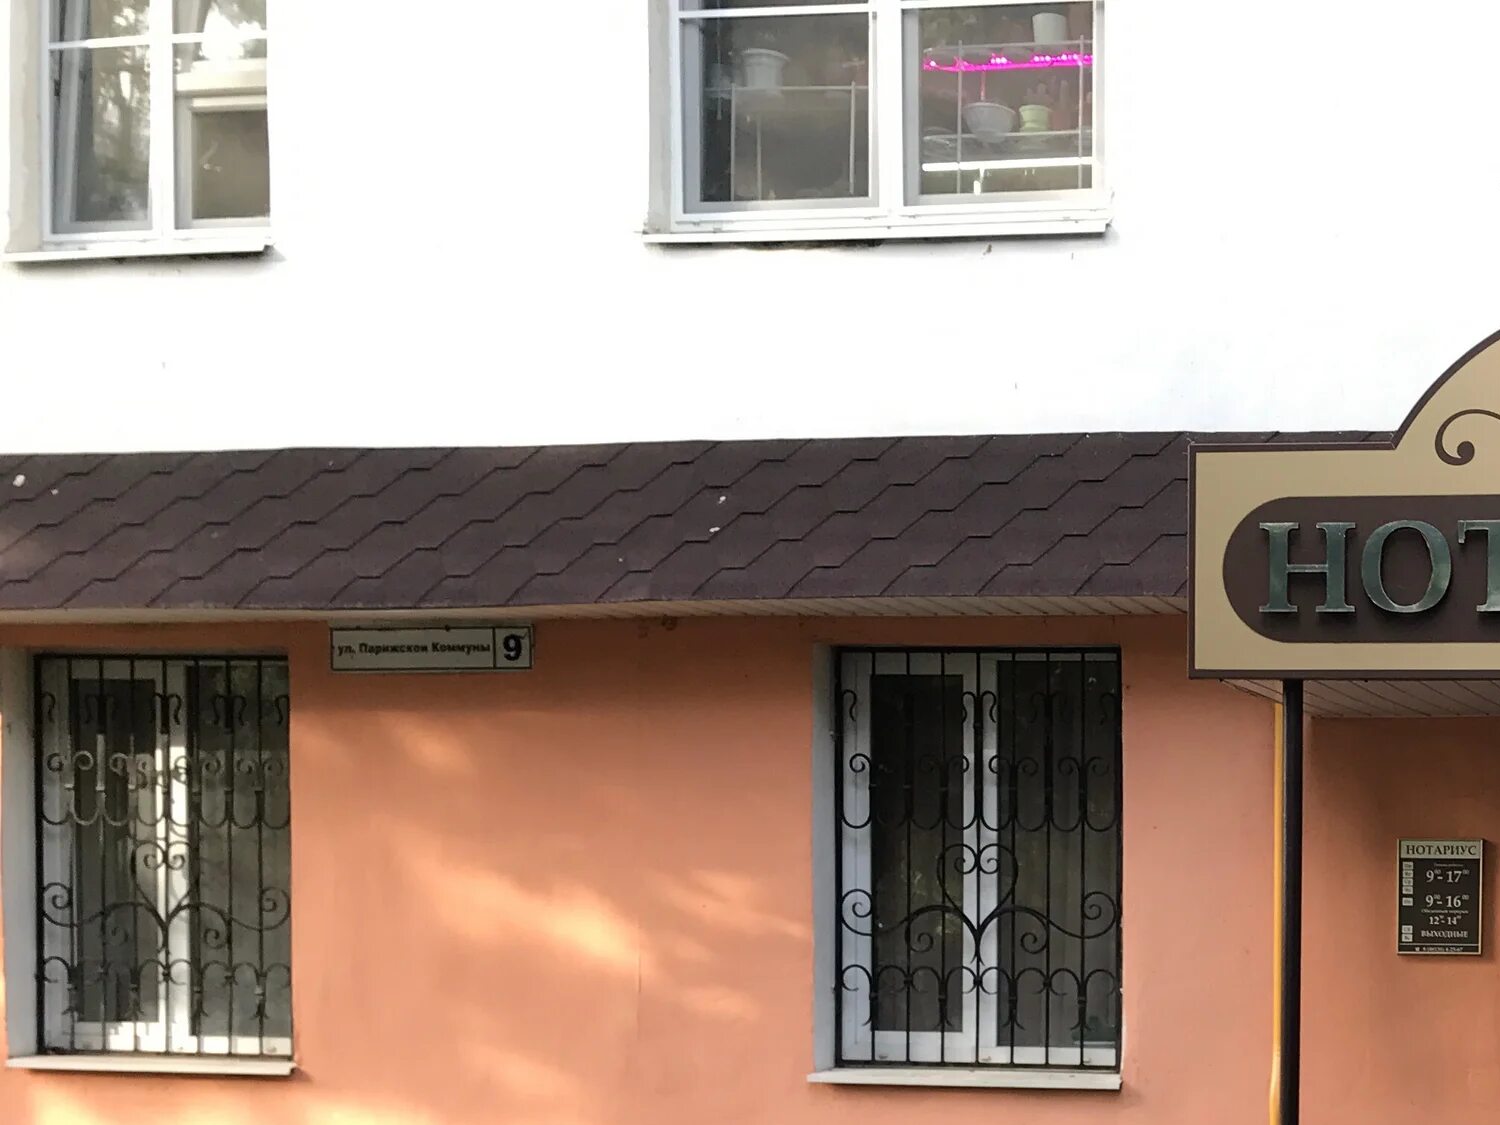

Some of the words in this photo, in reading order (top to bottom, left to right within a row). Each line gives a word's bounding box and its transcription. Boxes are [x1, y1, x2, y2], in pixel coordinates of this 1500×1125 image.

[431, 642, 491, 655] Коммуны
[503, 634, 522, 661] 9
[1405, 844, 1477, 856] НОТАРИУС
